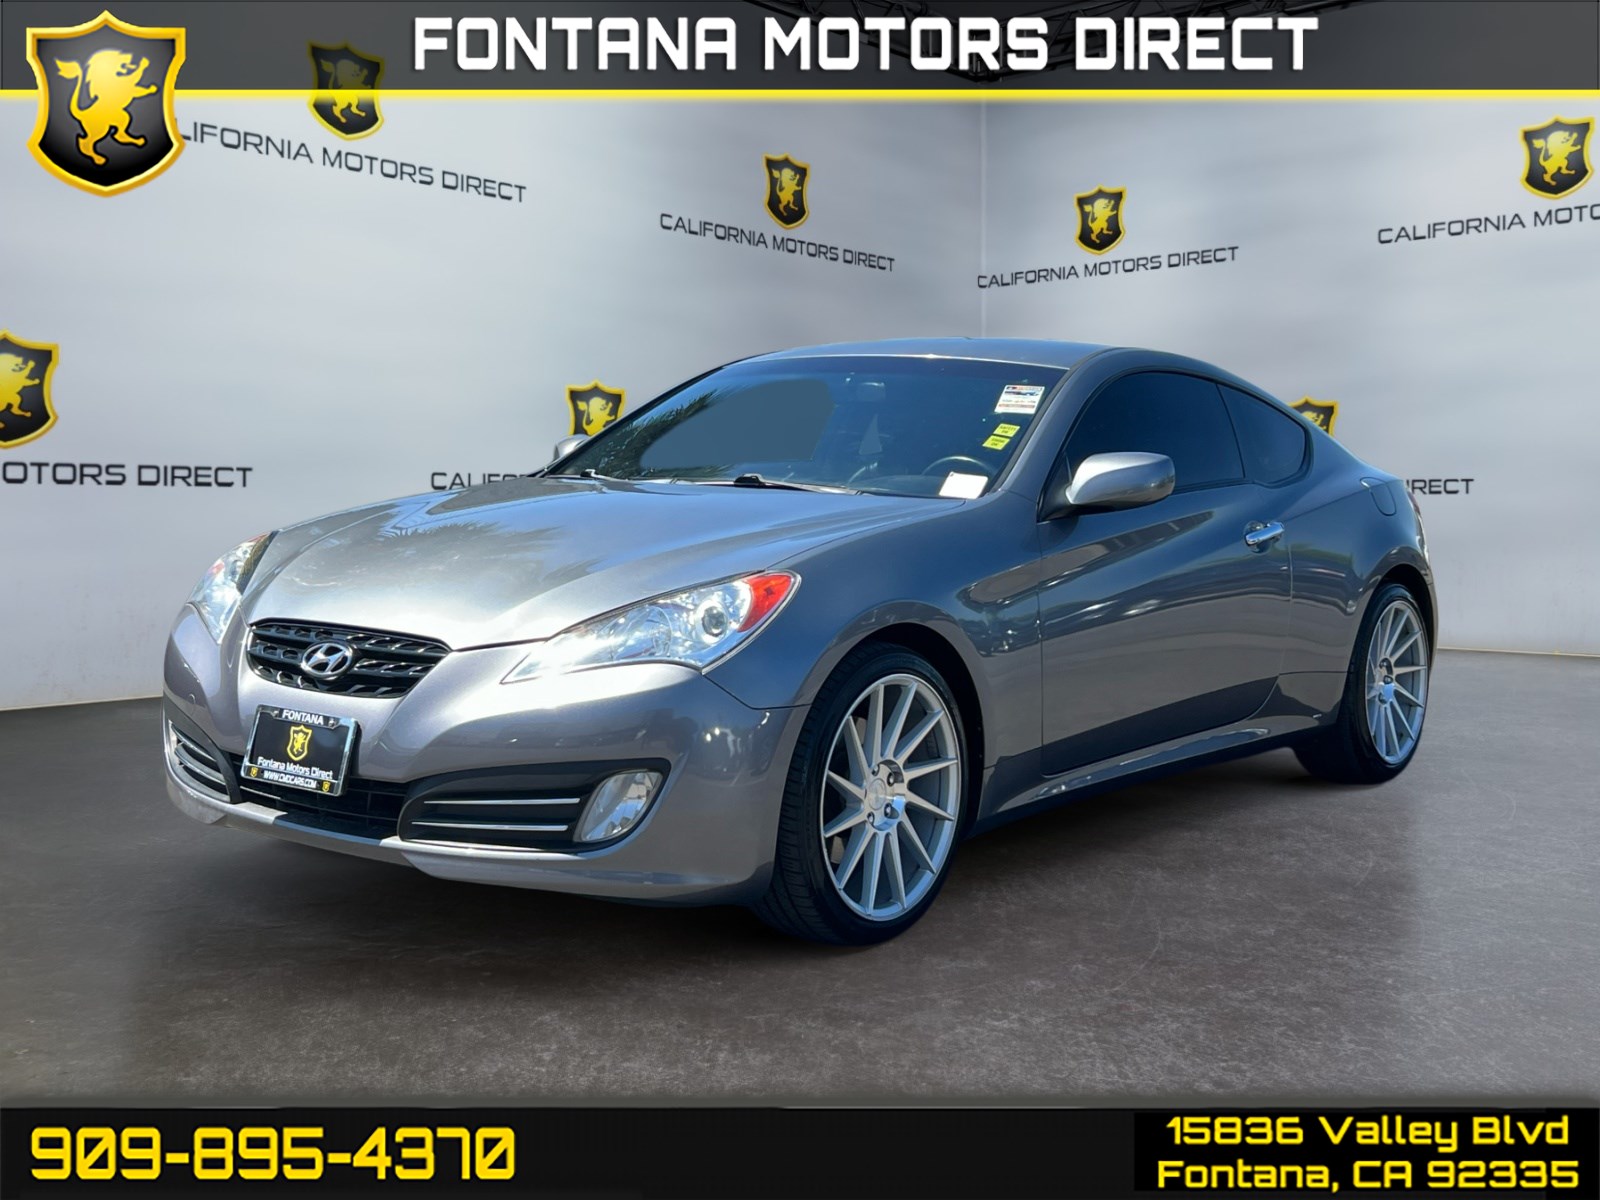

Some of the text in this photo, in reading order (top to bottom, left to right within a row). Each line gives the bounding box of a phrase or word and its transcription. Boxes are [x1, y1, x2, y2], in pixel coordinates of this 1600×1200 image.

[322, 146, 435, 187] MOTORS
[441, 169, 527, 203] DIRECT
[659, 213, 895, 272] CALIFORNIA MOTORS DIRECT
[1377, 213, 1526, 245] CALIFORNIA
[977, 246, 1240, 289] CALIFORNIA MOTORS DIRECT
[2, 461, 253, 488] OTORS DIRECT
[281, 709, 324, 726] FONTANA
[257, 756, 334, 780] Fontana Motors Direct
